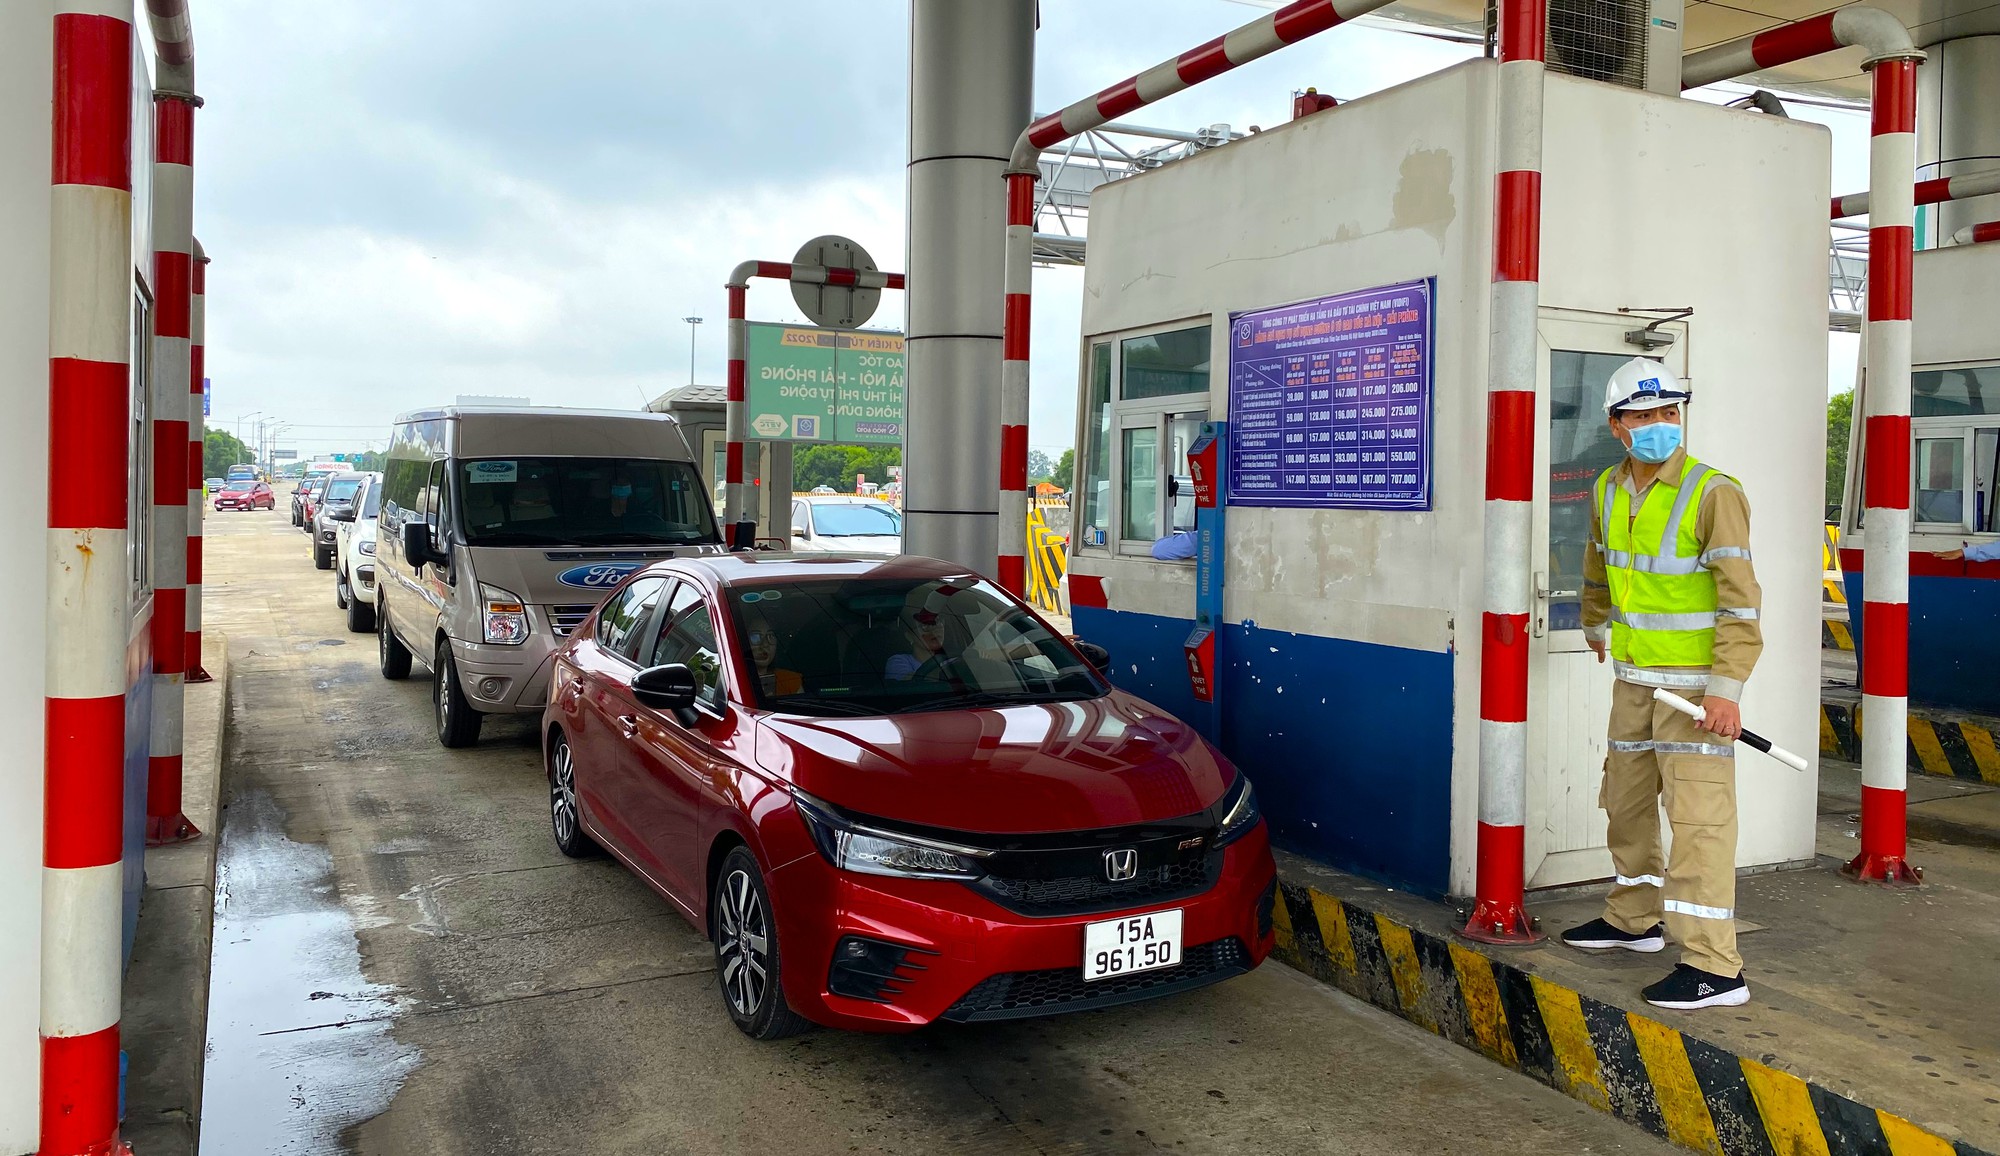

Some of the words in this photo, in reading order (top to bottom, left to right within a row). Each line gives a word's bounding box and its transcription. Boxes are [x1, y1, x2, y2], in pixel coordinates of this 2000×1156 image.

[1397, 306, 1418, 323] PHÒNG
[1335, 387, 1357, 398] 147.000
[1363, 385, 1386, 396] 187.000
[1392, 383, 1417, 393] 206.000
[1287, 392, 1303, 402] 39.000
[1311, 390, 1328, 400] 98.000
[1362, 407, 1385, 418] 245.000
[1391, 406, 1417, 416] 275.000
[1286, 413, 1303, 422] 59.000
[1286, 434, 1303, 443] 69.000
[1309, 433, 1329, 442] 157.000
[1335, 431, 1356, 441] 245.000
[1362, 430, 1385, 440] 314.000
[1391, 428, 1416, 439] 344.000
[1309, 454, 1330, 463] 255.000
[1362, 452, 1385, 462] 501.000
[1391, 451, 1416, 461] 550.000
[1286, 475, 1305, 484] 147.000
[1310, 475, 1330, 484] 353.000
[1336, 475, 1357, 484] 530.000
[1363, 474, 1385, 484] 687.000
[1391, 474, 1416, 484] 707.000
[1203, 530, 1210, 542] GO
[584, 566, 637, 586] Fo
[1117, 917, 1155, 945] 15A
[1096, 940, 1171, 975] 961.50
